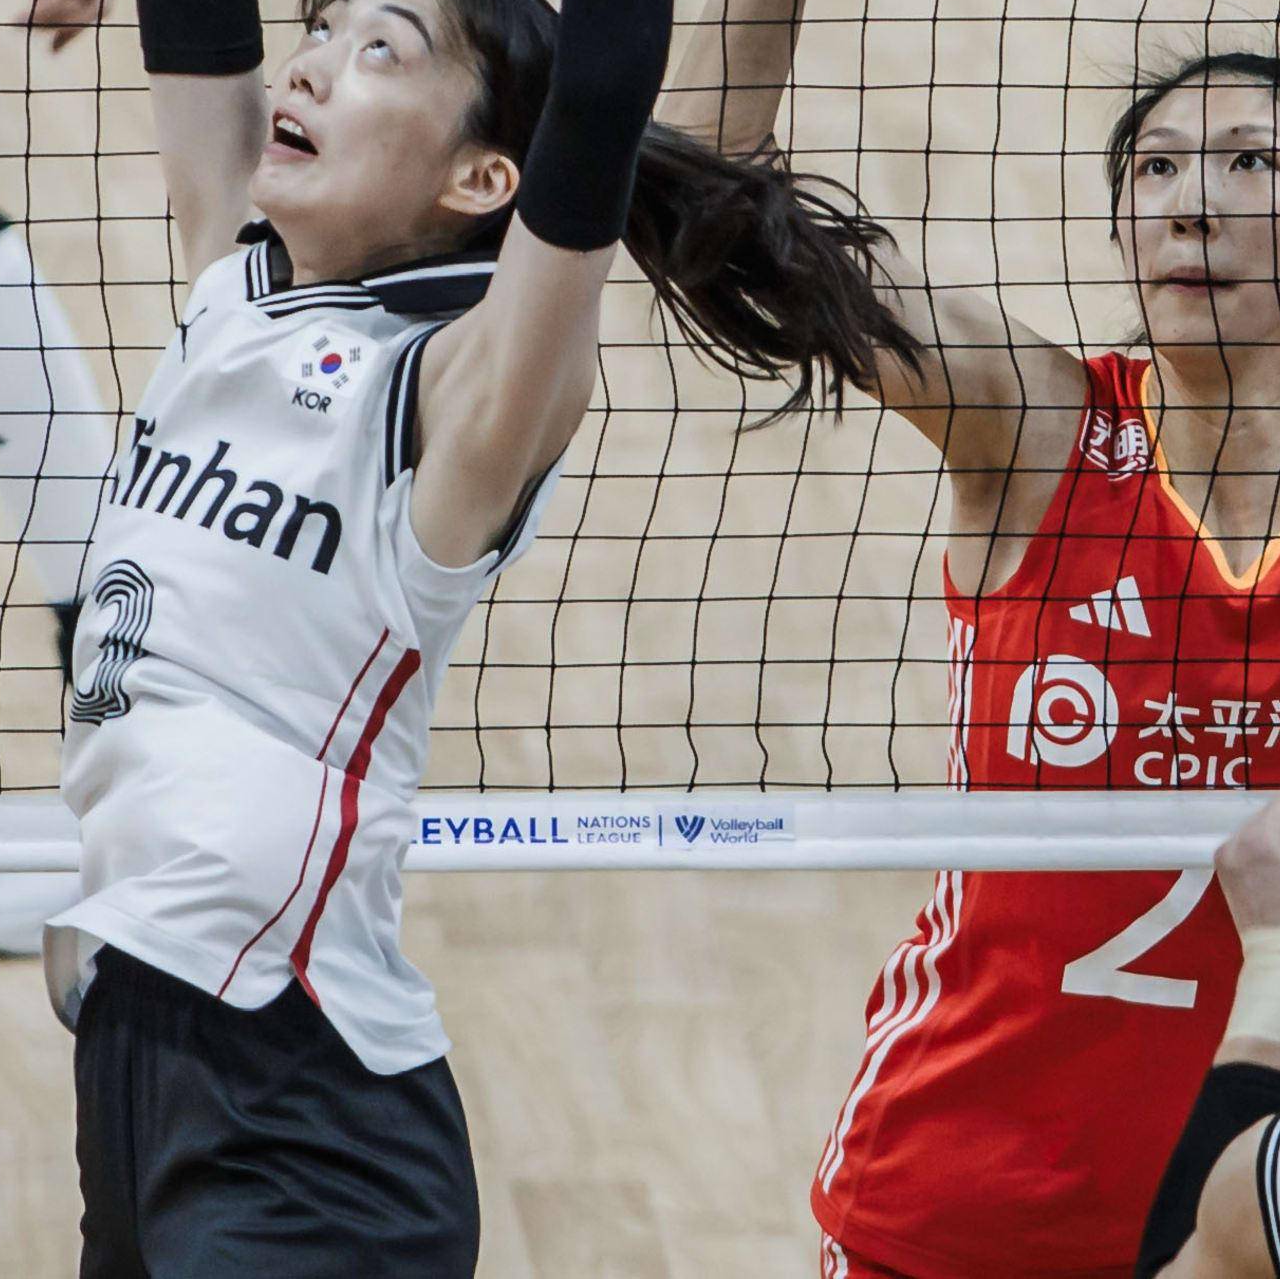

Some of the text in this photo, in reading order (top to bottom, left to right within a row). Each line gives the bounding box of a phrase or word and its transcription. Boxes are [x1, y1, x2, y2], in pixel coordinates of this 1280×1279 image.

[291, 386, 332, 414] KOR
[108, 417, 342, 575] inhan
[1133, 750, 1253, 790] CPIC
[410, 816, 784, 845] EYBALL NATIONS Volleyball
[577, 832, 759, 844] LEAGUE World
